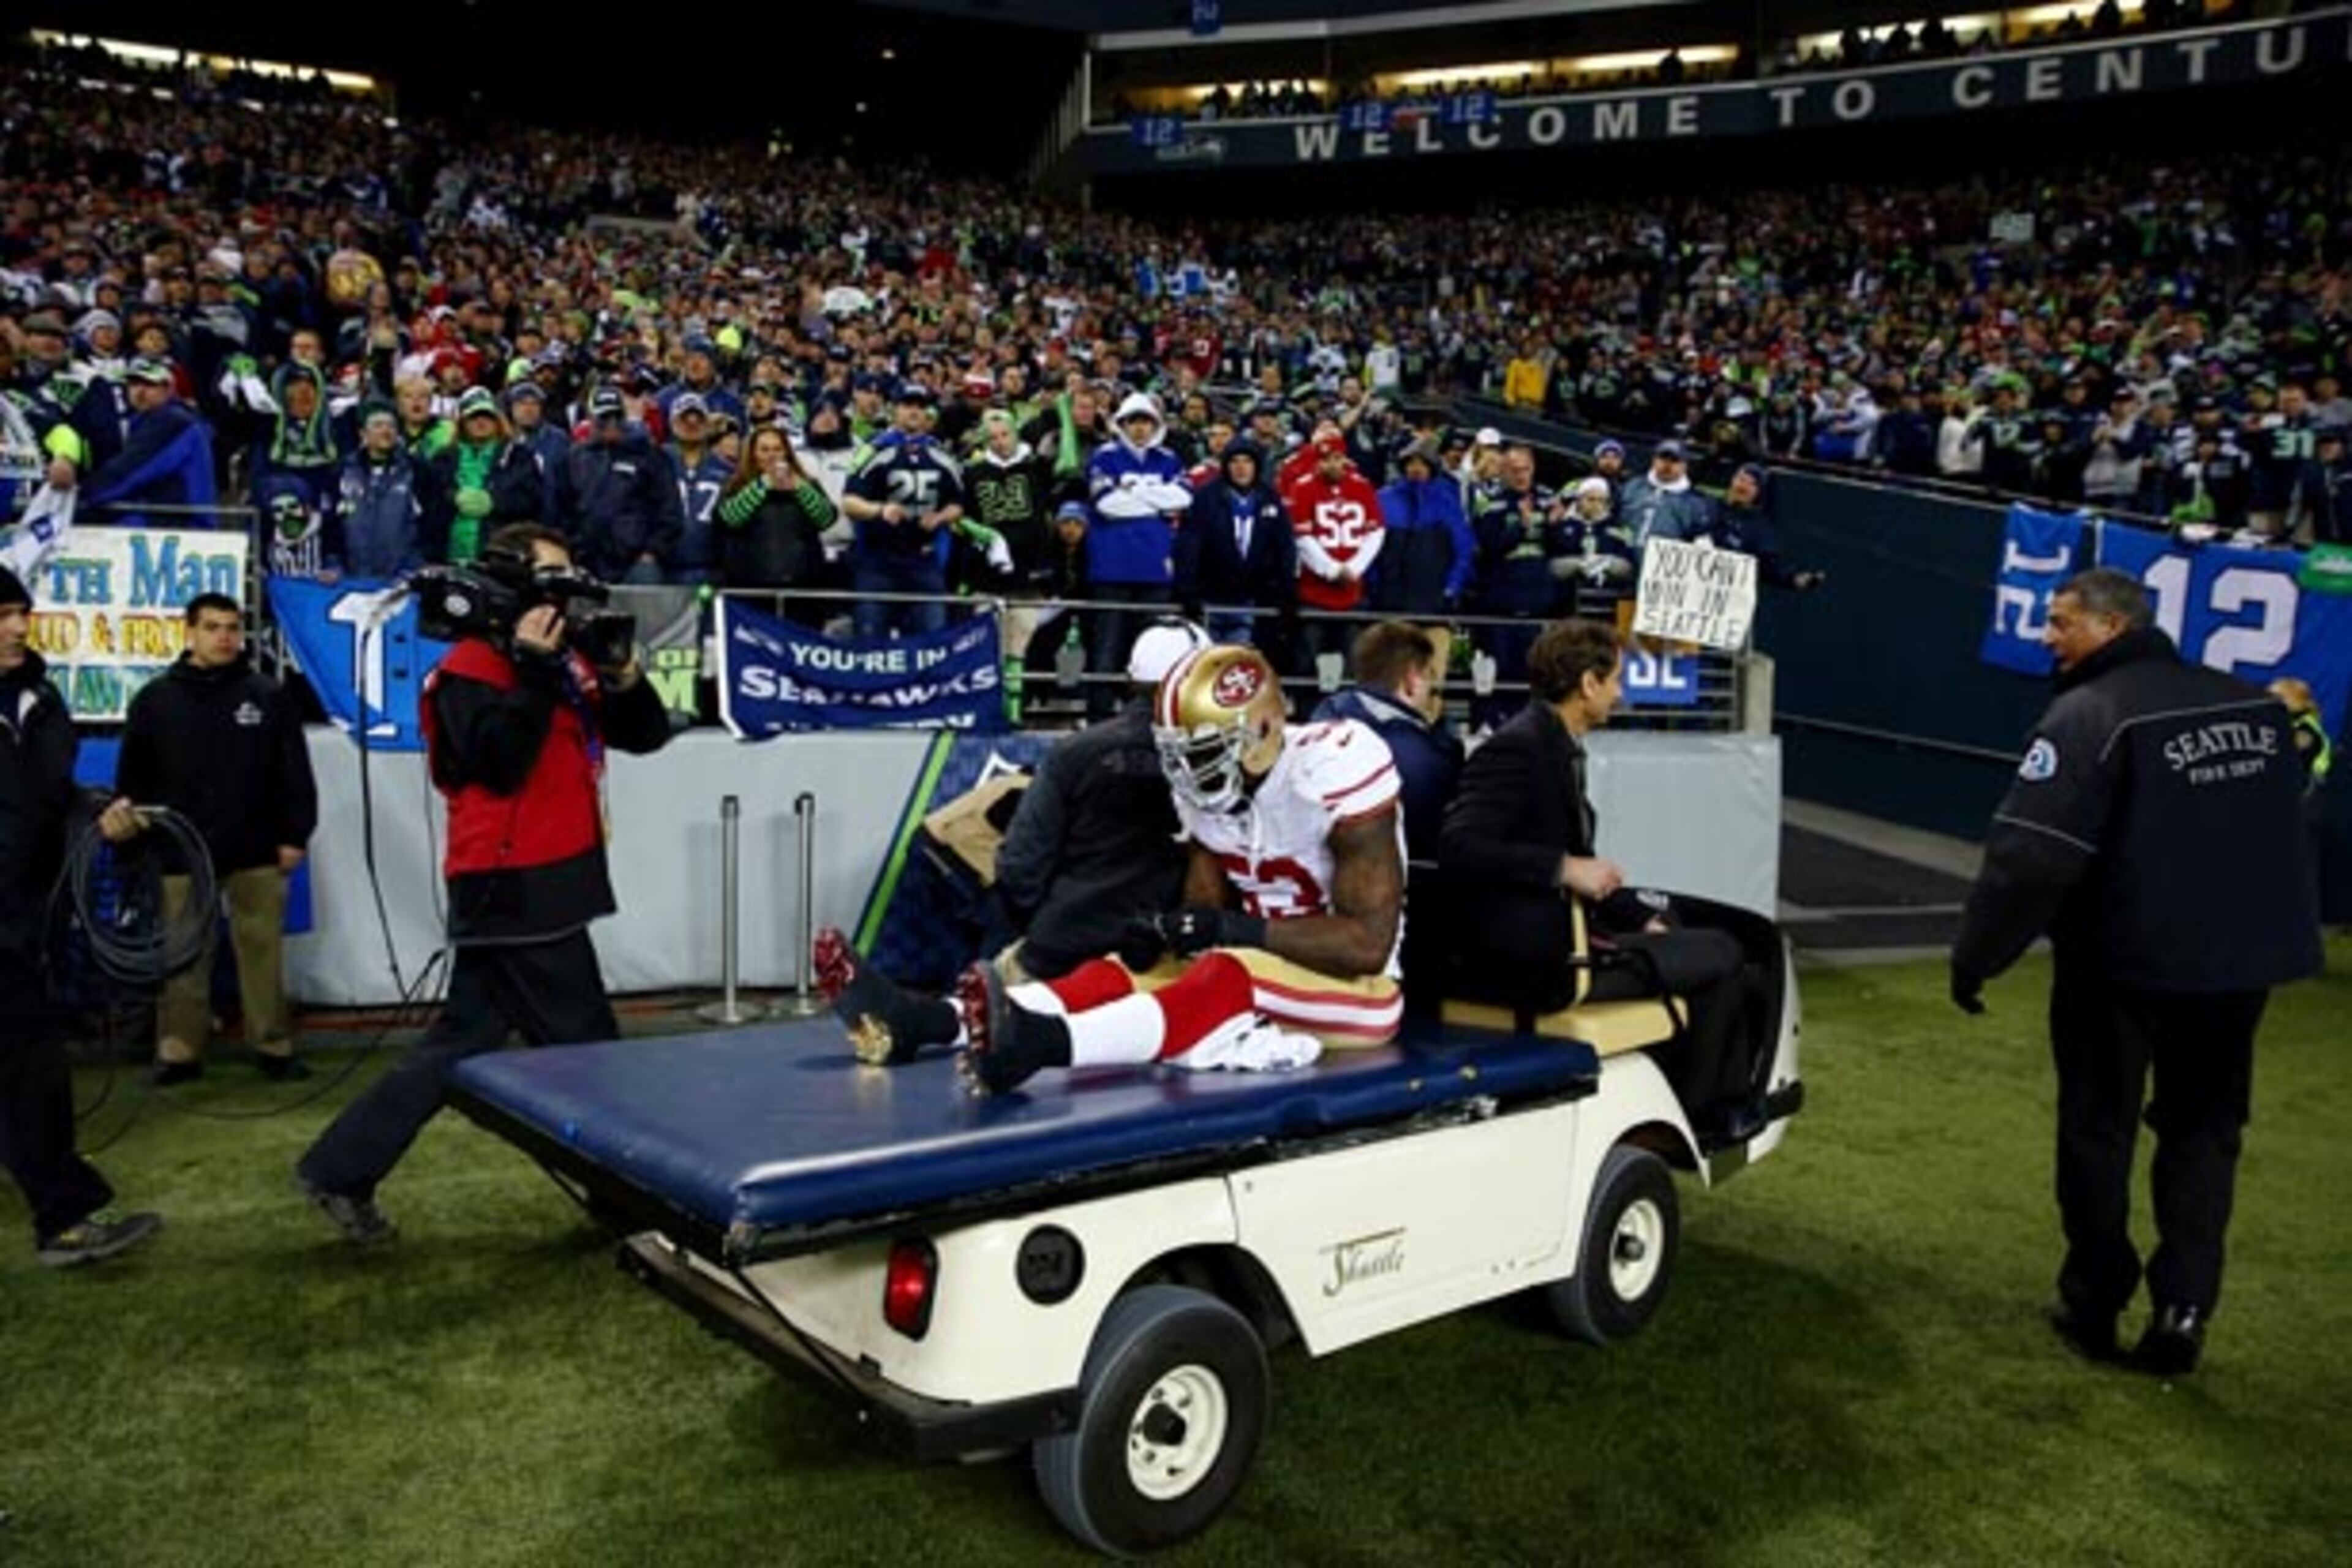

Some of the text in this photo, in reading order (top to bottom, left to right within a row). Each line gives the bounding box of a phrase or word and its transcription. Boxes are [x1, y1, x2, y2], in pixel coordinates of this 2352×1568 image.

[1295, 26, 2352, 163] WELCOME TO CENTU
[1452, 94, 1485, 123] 12
[1142, 117, 1175, 146] 12
[1349, 103, 1383, 129] 12
[1316, 500, 1366, 548] 52
[129, 533, 238, 608] Man
[1651, 541, 1689, 579] YOU
[1645, 579, 1730, 617] WIN IN
[2145, 554, 2299, 673] 12
[1643, 608, 1741, 647] SEATTLE
[790, 641, 948, 673] YOU'RE IN
[739, 665, 998, 707] SEAAWKS
[2163, 722, 2278, 771] SEATTLE
